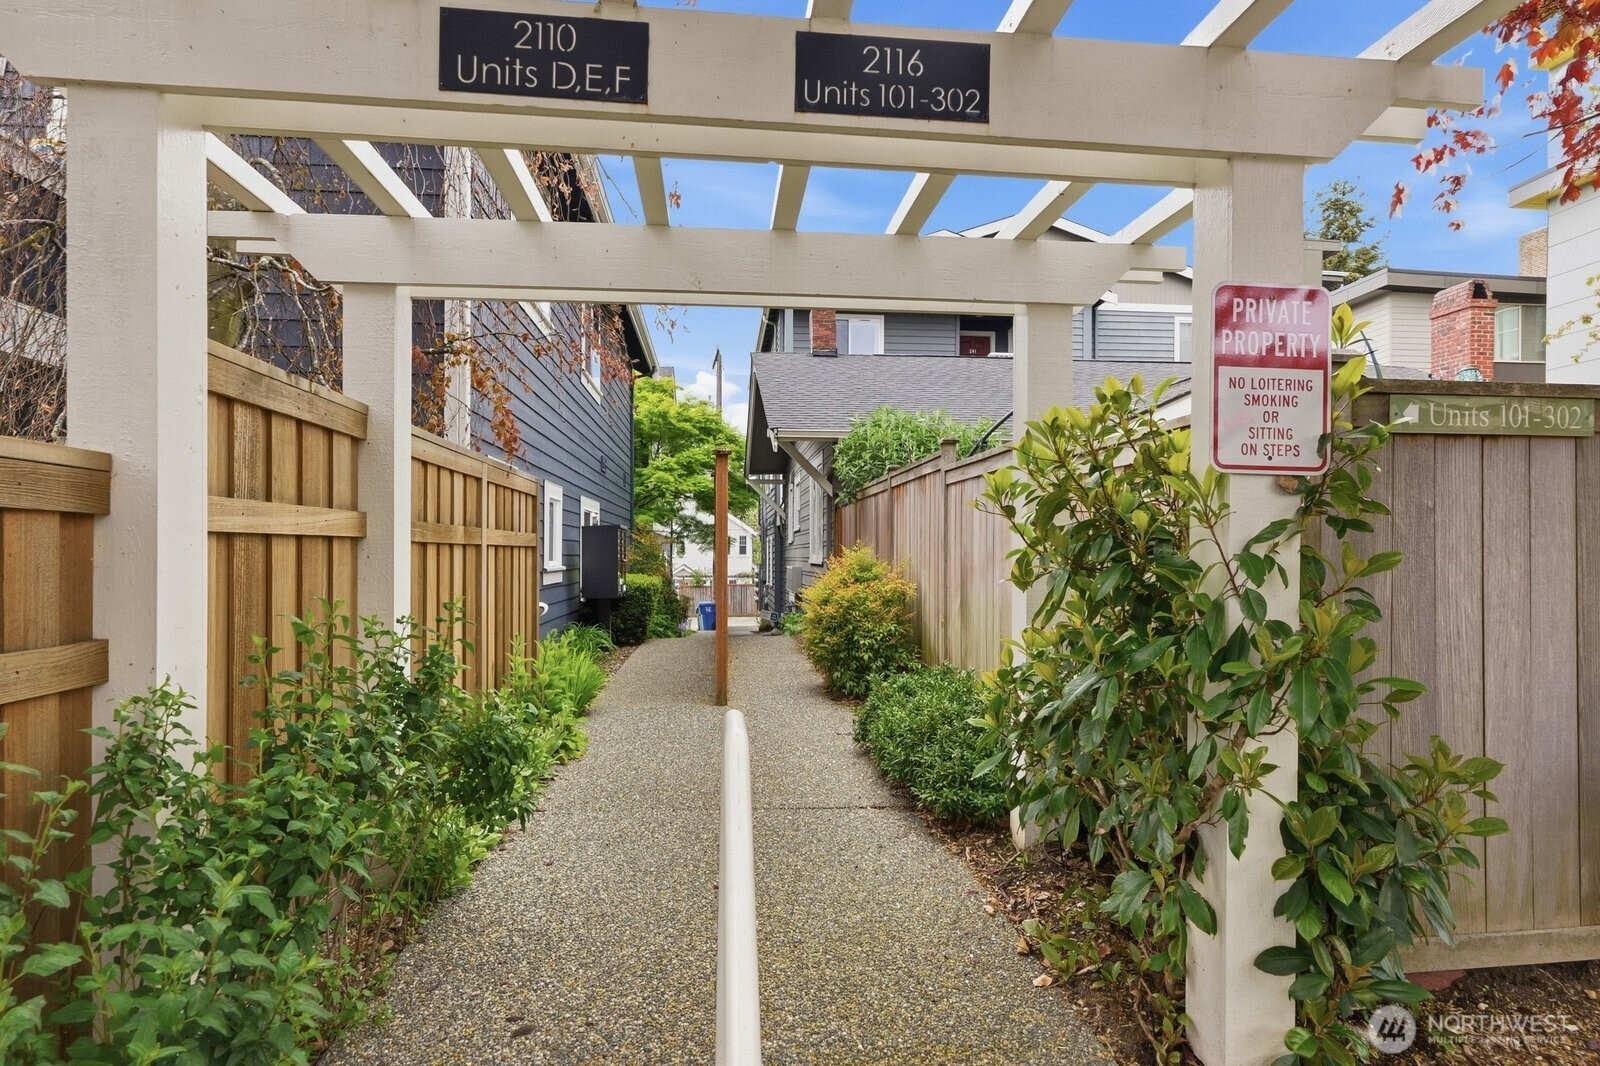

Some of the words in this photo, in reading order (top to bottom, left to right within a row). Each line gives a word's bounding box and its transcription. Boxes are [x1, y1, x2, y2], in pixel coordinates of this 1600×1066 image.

[514, 20, 577, 52] 2110
[457, 53, 539, 88] Units
[552, 61, 631, 95] D,E,F
[862, 45, 924, 77] 2116
[804, 79, 870, 107] Units
[879, 83, 981, 114] 101-302
[1232, 297, 1312, 326] PRIVATE
[1221, 329, 1321, 358] PROPERTY
[1228, 376, 1246, 390] NO
[1251, 377, 1313, 392] LOITERING
[1244, 393, 1298, 408] SMOKING
[1263, 410, 1279, 424] OR
[1429, 402, 1489, 427] Units
[1501, 404, 1582, 429] 101-302
[1248, 426, 1293, 440] SITTING
[1241, 443, 1257, 456] ON
[1263, 443, 1300, 457] STEPS
